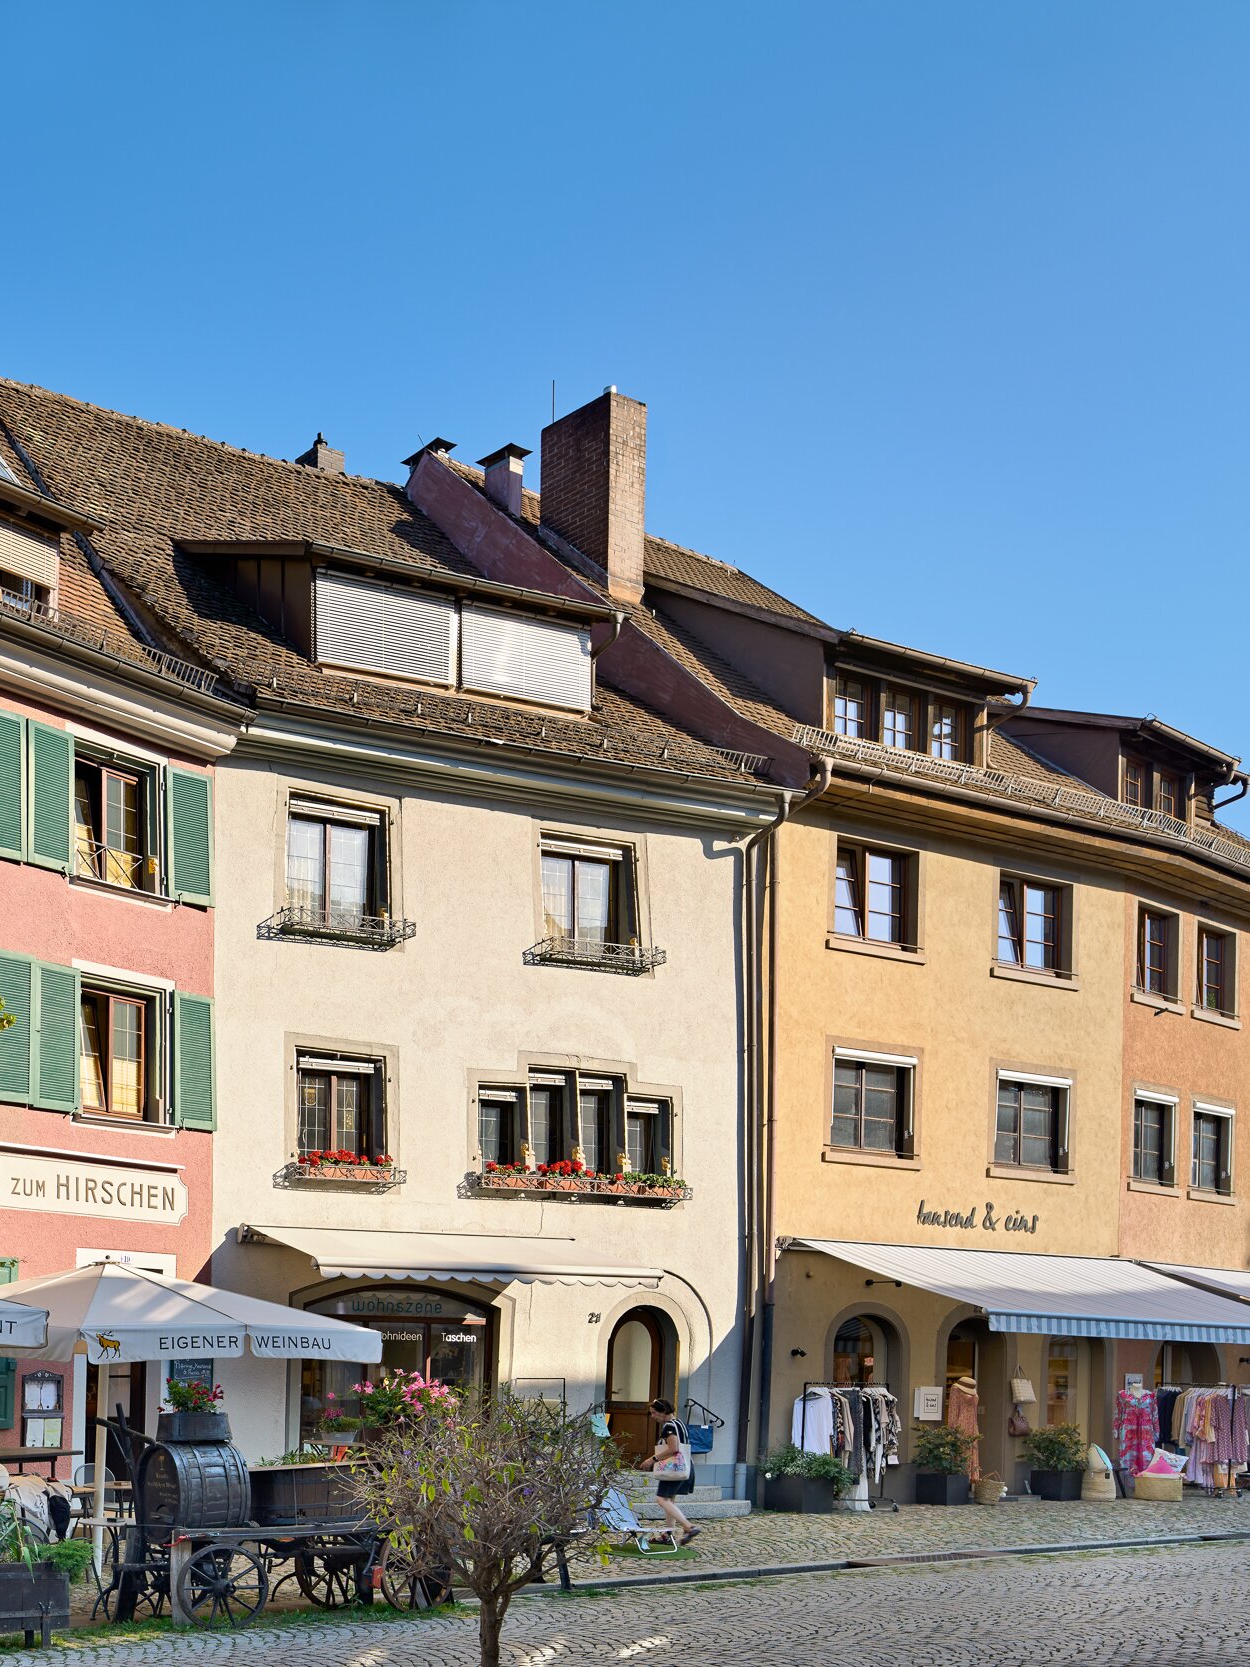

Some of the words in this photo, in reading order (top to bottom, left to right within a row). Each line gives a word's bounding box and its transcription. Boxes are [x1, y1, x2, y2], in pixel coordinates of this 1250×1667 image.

[10, 1176, 47, 1198] ZUM
[56, 1174, 176, 1211] HIRSCHEN
[916, 1199, 977, 1230] tausend
[982, 1201, 1001, 1231] &
[1004, 1210, 1040, 1235] eins
[351, 1298, 443, 1314] wohnszene
[159, 1335, 239, 1350] EIGENER
[255, 1335, 332, 1350] WEINBAU
[382, 1331, 423, 1341] ohnideen
[441, 1332, 477, 1343] Taschen
